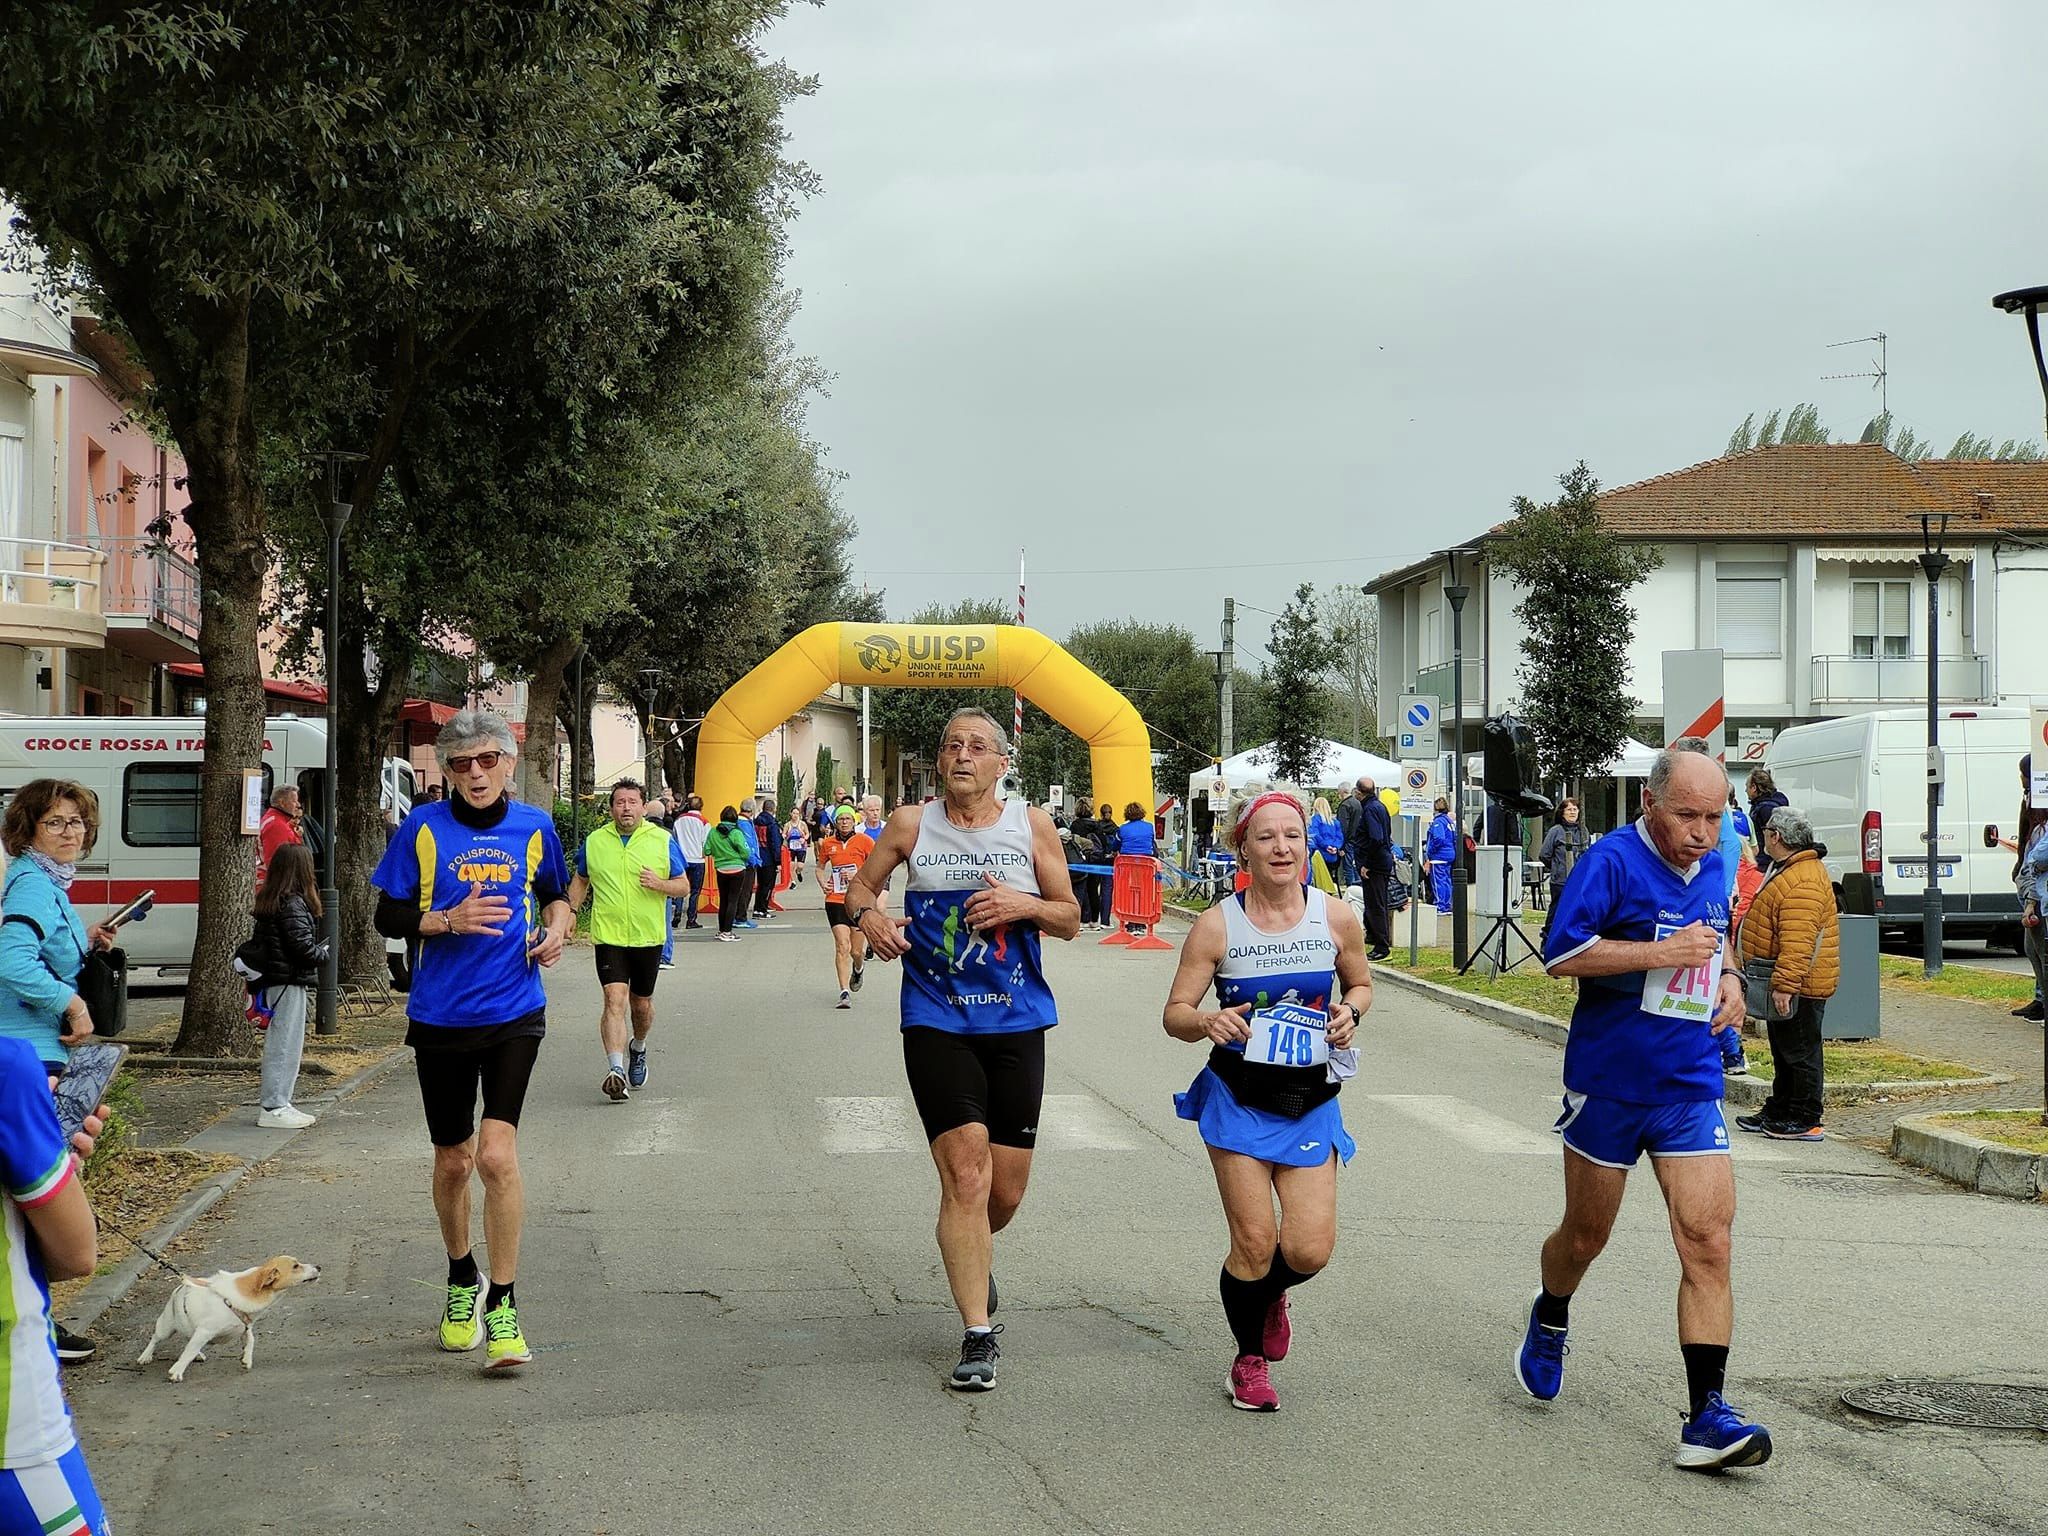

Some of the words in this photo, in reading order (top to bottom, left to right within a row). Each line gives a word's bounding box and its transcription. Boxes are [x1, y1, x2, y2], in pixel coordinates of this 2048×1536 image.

[907, 635, 986, 661] UISP
[907, 662, 942, 671] UNIONE
[945, 662, 986, 671] ITALIANA
[24, 738, 92, 751] CROCE
[99, 738, 169, 751] ROSSA
[448, 848, 519, 872] POLISPORTIVA
[916, 853, 1029, 867] QUADRILATERO
[457, 863, 512, 883] AVIS
[1228, 939, 1332, 959] QUADRILATERO
[1256, 955, 1312, 969] FERRARA
[1666, 957, 1711, 998] 214
[946, 993, 1007, 1006] VENTURA
[1267, 1022, 1313, 1066] 148
